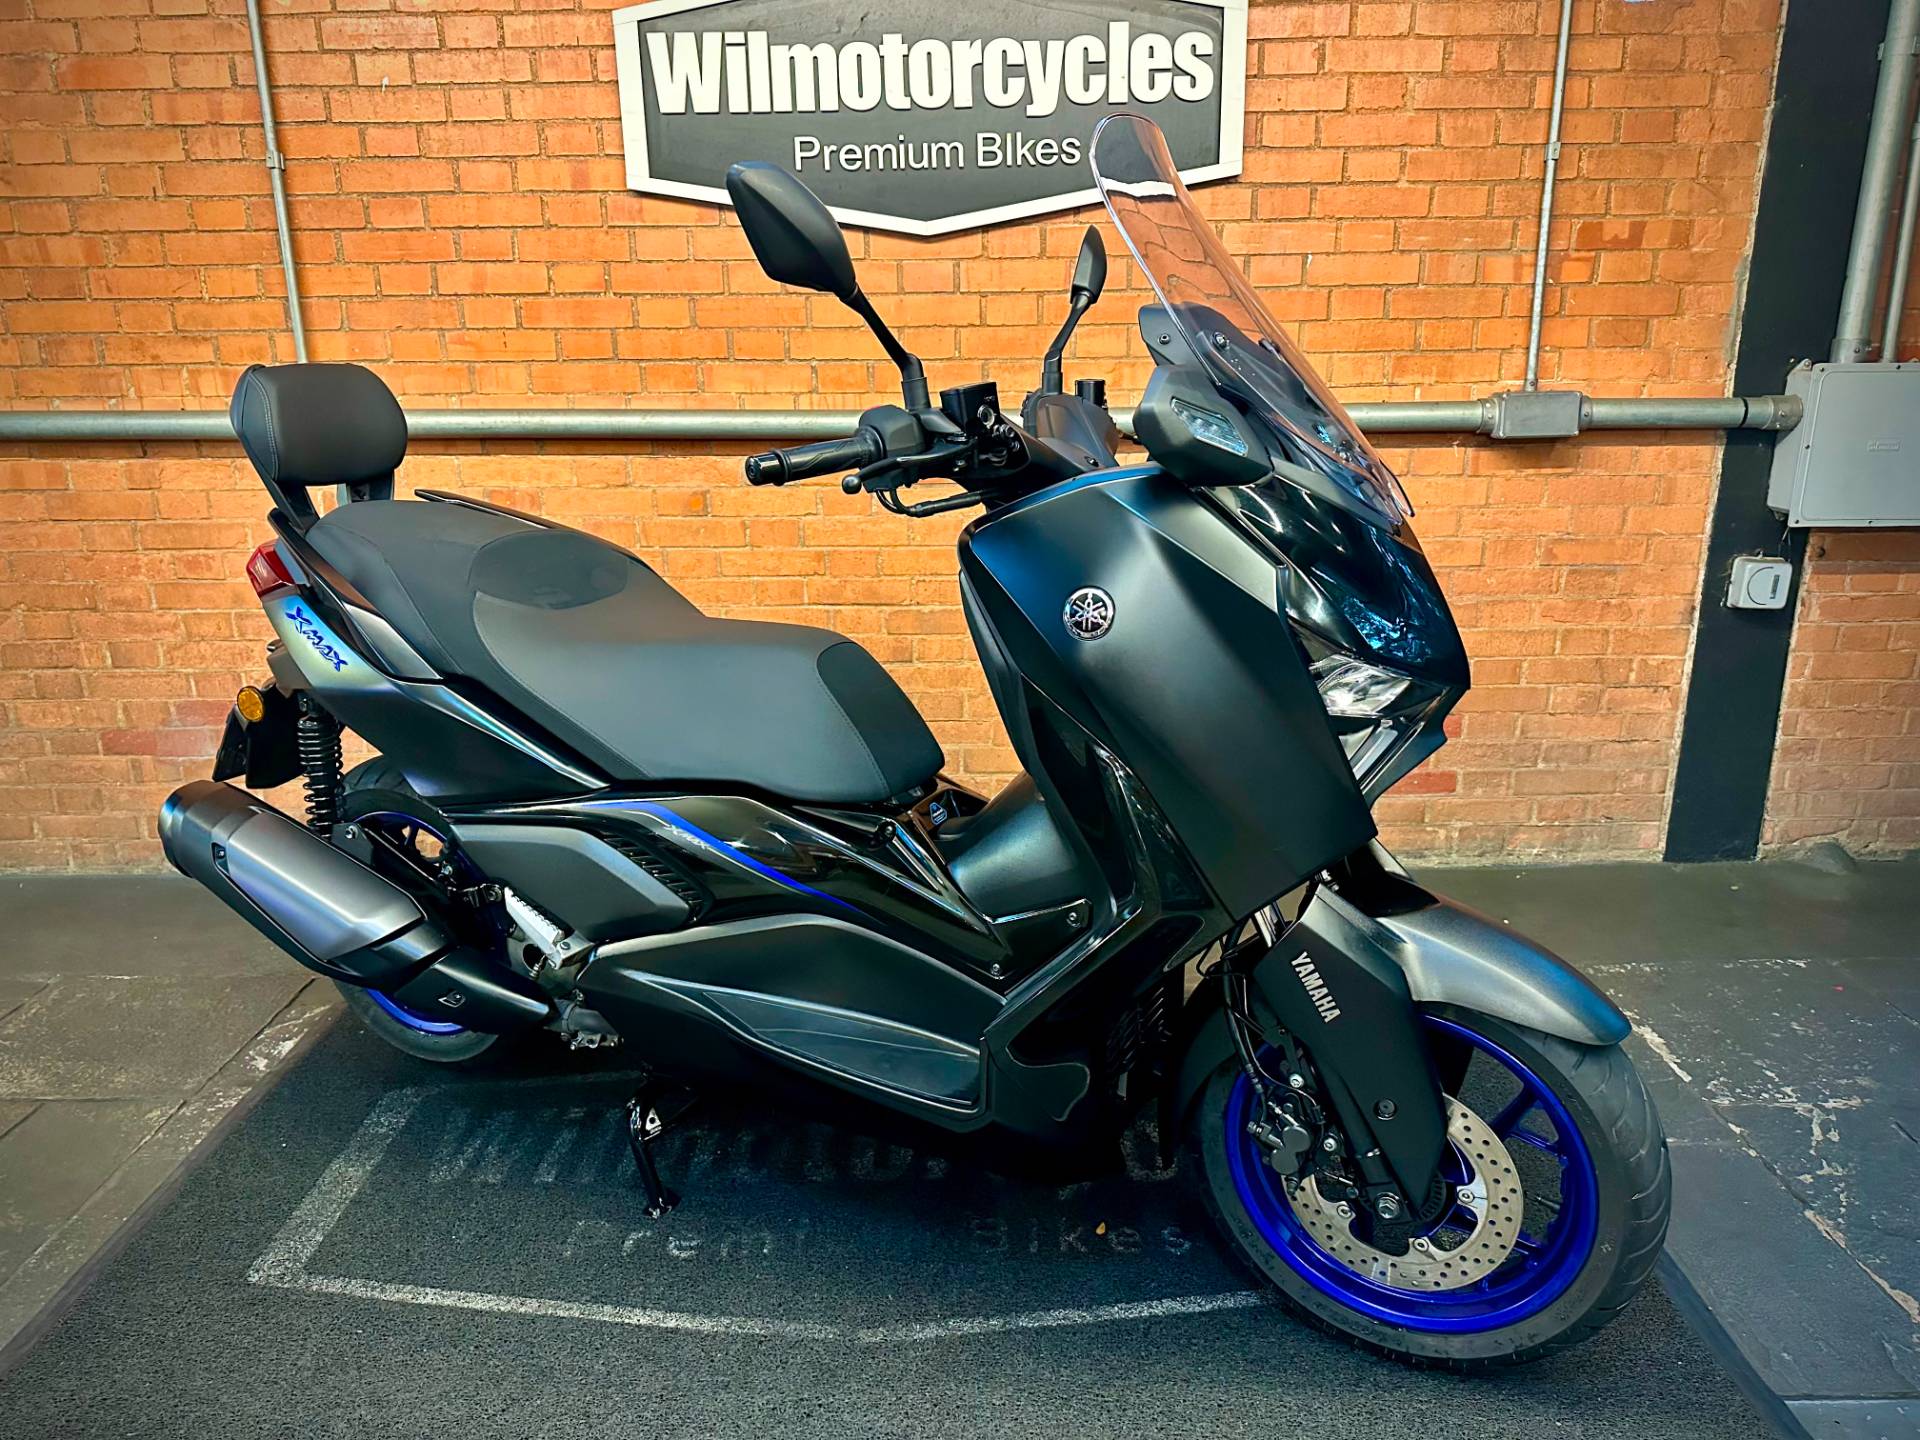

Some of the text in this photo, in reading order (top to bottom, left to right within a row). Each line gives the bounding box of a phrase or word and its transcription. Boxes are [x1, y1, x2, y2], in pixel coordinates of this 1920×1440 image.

[646, 21, 1214, 117] Wilmotorcycles
[793, 133, 966, 171] Premium
[1291, 951, 1341, 1023] YAMAHA
